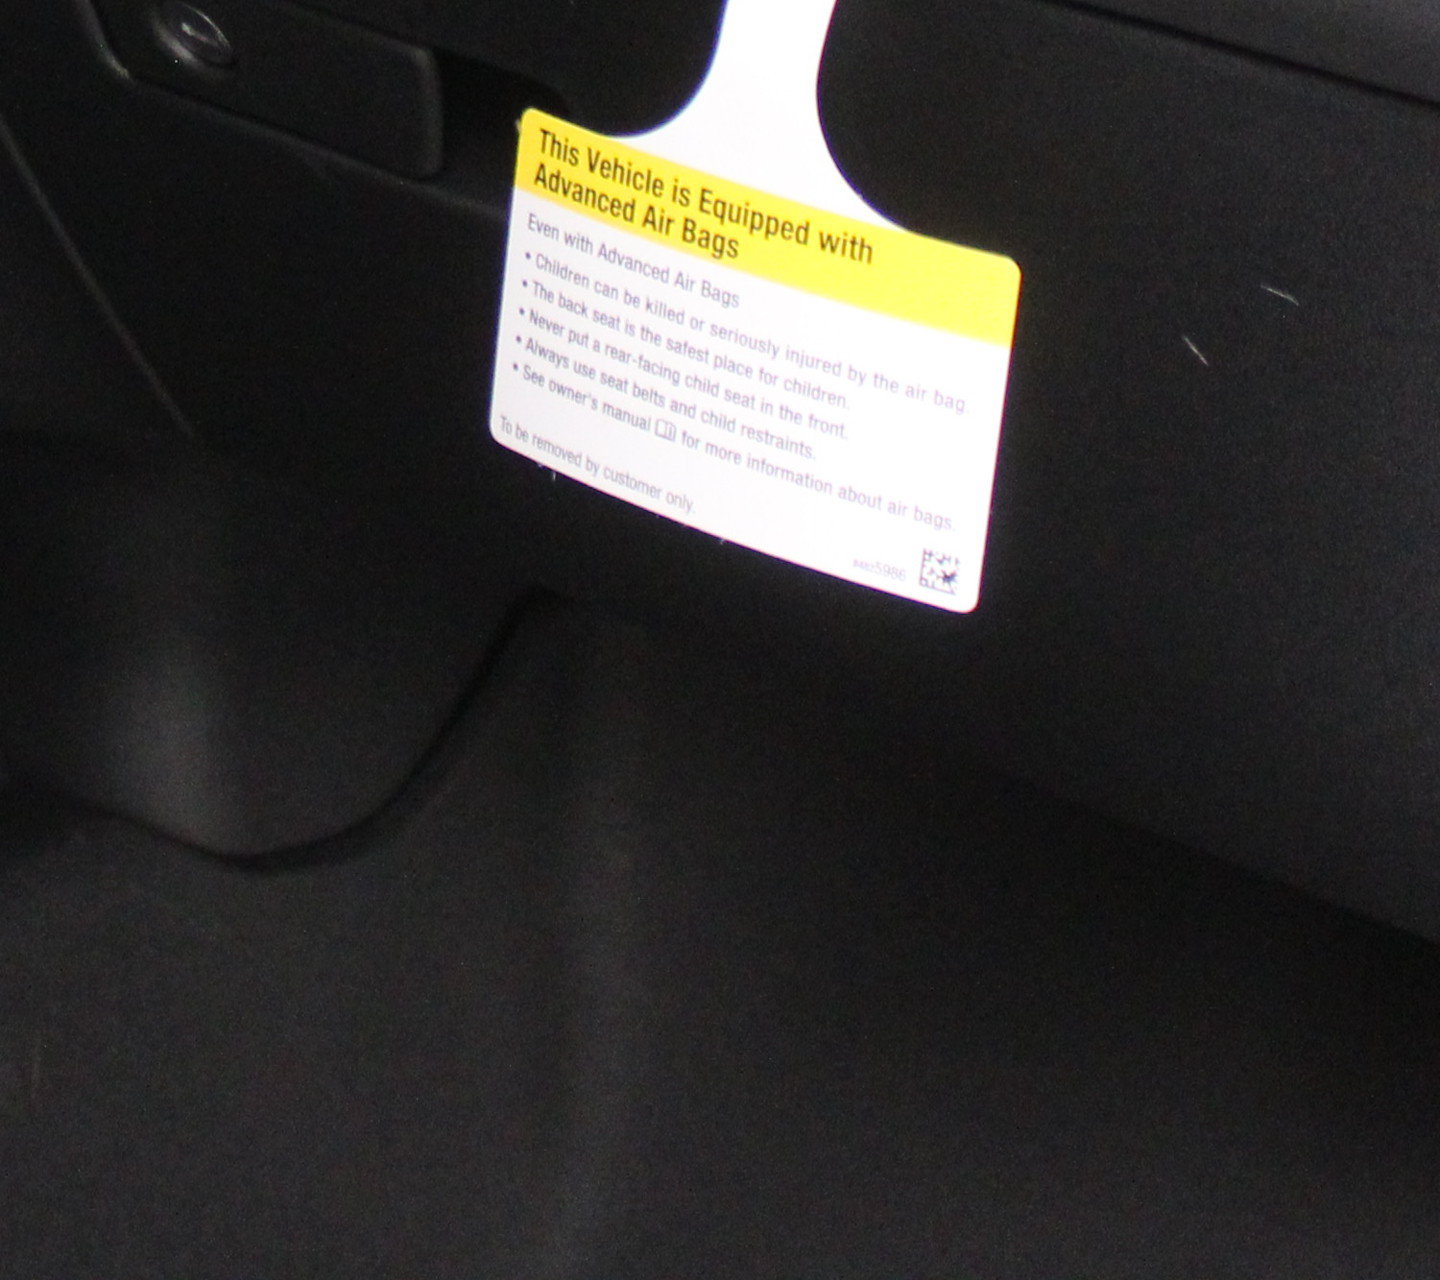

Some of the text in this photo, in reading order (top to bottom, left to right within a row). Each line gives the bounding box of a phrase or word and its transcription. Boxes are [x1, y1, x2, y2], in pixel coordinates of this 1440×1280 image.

[534, 162, 739, 259] Advanced Air Bags
[539, 127, 873, 264] This Vehicle is Equipped with
[526, 211, 739, 308] Even with Advanced Air Bags
[529, 306, 566, 338] Never
[568, 328, 592, 350] put
[593, 338, 601, 354] a
[604, 342, 681, 387] rear-facing
[684, 373, 720, 398] child
[723, 388, 756, 410] seat
[760, 397, 774, 416] in
[779, 403, 803, 425] the
[532, 278, 555, 305] The
[558, 288, 590, 319] back
[592, 307, 621, 332] seat
[624, 317, 636, 337] is
[639, 323, 662, 347] the
[665, 337, 710, 365] safest
[712, 354, 753, 379] place
[758, 366, 780, 386] for
[535, 251, 590, 290] Children
[593, 279, 619, 301] can
[622, 287, 641, 309] be
[645, 295, 686, 325] killed
[690, 316, 706, 332] or
[709, 323, 780, 360] seriously
[785, 344, 842, 377] injured
[847, 364, 867, 387] by
[873, 372, 899, 393] the
[905, 384, 928, 400] air
[524, 335, 570, 370] Always
[573, 359, 597, 381] use
[599, 369, 629, 395] seat
[631, 379, 667, 409] belts
[669, 397, 697, 420] and
[700, 408, 736, 433] child
[499, 412, 513, 435] To
[514, 421, 529, 443] be
[531, 433, 583, 468] removed
[584, 454, 601, 477] by
[603, 465, 663, 500] customer
[522, 361, 545, 388] See
[548, 377, 598, 411] owner's
[602, 400, 652, 431] manual
[680, 429, 702, 450] for
[705, 441, 742, 465] more
[746, 452, 834, 495] information
[838, 485, 883, 511] about
[887, 501, 908, 516] air
